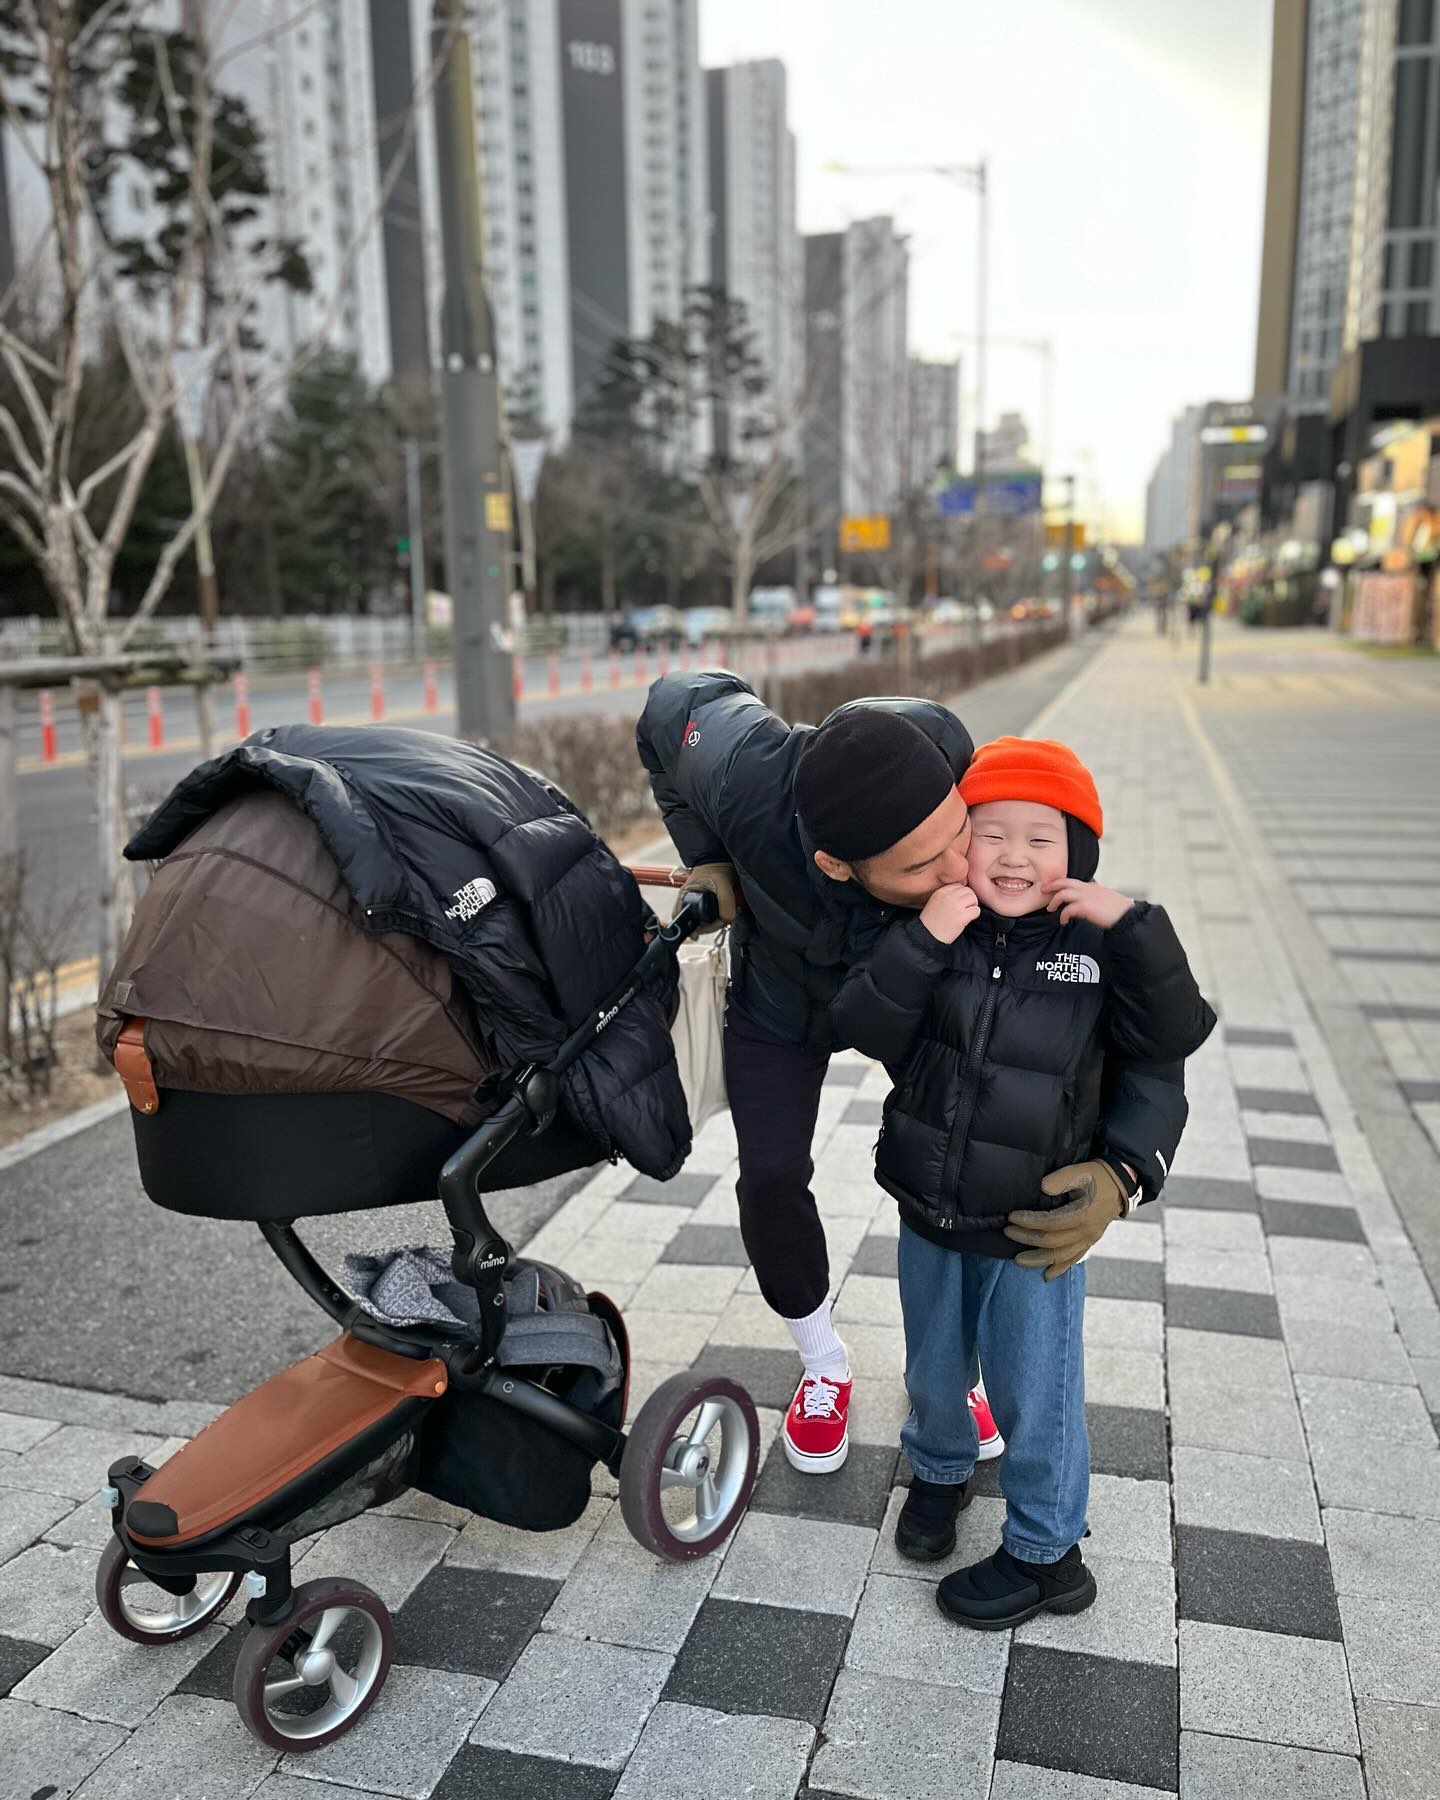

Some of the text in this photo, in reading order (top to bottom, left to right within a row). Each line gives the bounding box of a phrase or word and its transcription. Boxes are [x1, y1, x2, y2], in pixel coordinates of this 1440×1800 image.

[453, 882, 475, 901] THE
[444, 889, 481, 920] NORTH
[460, 900, 485, 922] FACE
[1055, 953, 1080, 964] THE
[1035, 961, 1079, 973] NORTH
[1047, 971, 1079, 983] FACE
